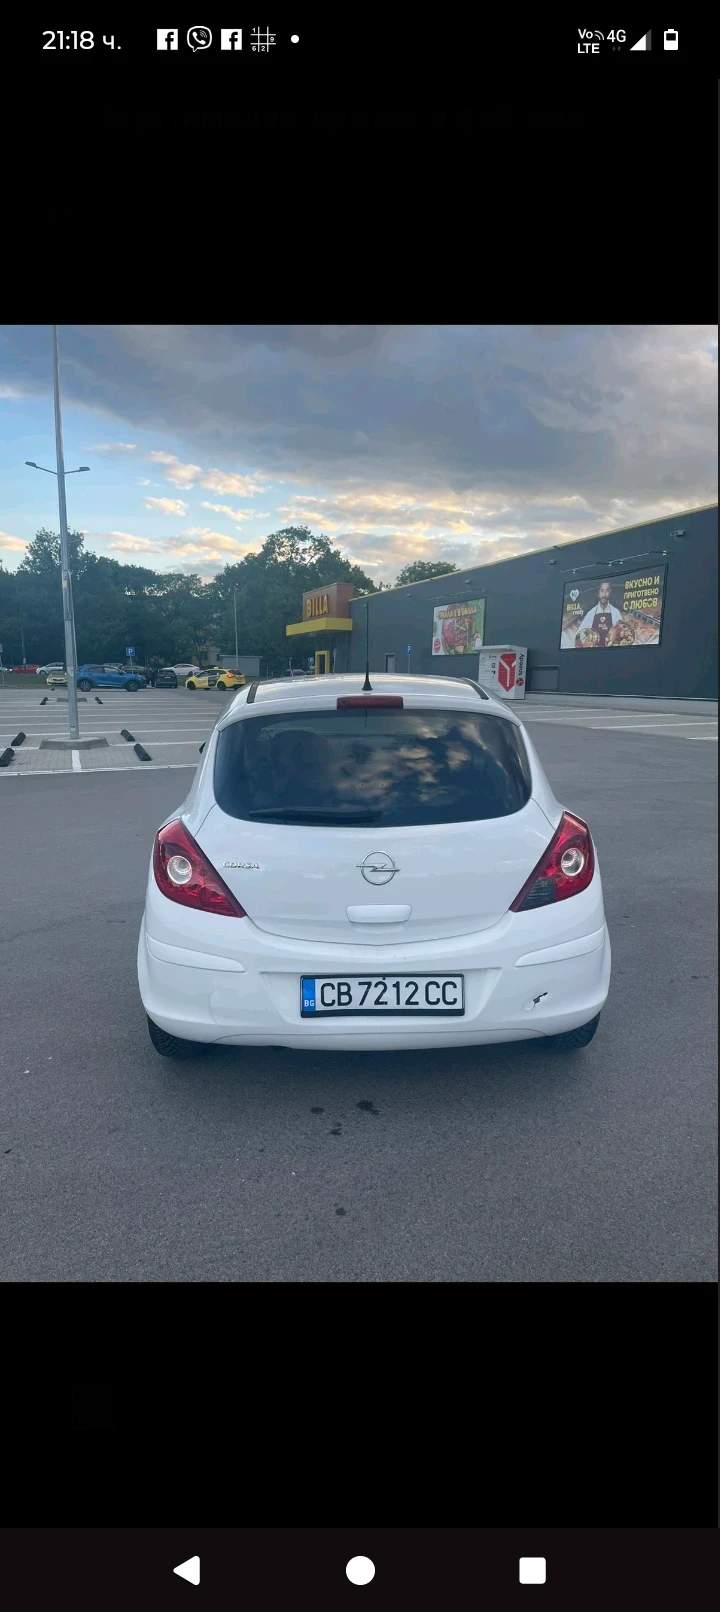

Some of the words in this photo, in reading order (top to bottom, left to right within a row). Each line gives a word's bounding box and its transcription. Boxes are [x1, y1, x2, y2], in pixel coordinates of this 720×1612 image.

[624, 577, 653, 590] ВКУСНО
[653, 575, 660, 585] И
[623, 587, 659, 600] ПРИГОТВЕНО
[306, 594, 329, 618] BILLA
[566, 603, 581, 612] BILLA
[623, 601, 629, 611] С
[629, 597, 658, 610] ЛЮБОВ
[518, 653, 526, 676] speedy
[222, 860, 260, 870] CORSA
[357, 980, 420, 1006] 7212
[424, 980, 458, 1006] CC
[304, 999, 315, 1007] BG
